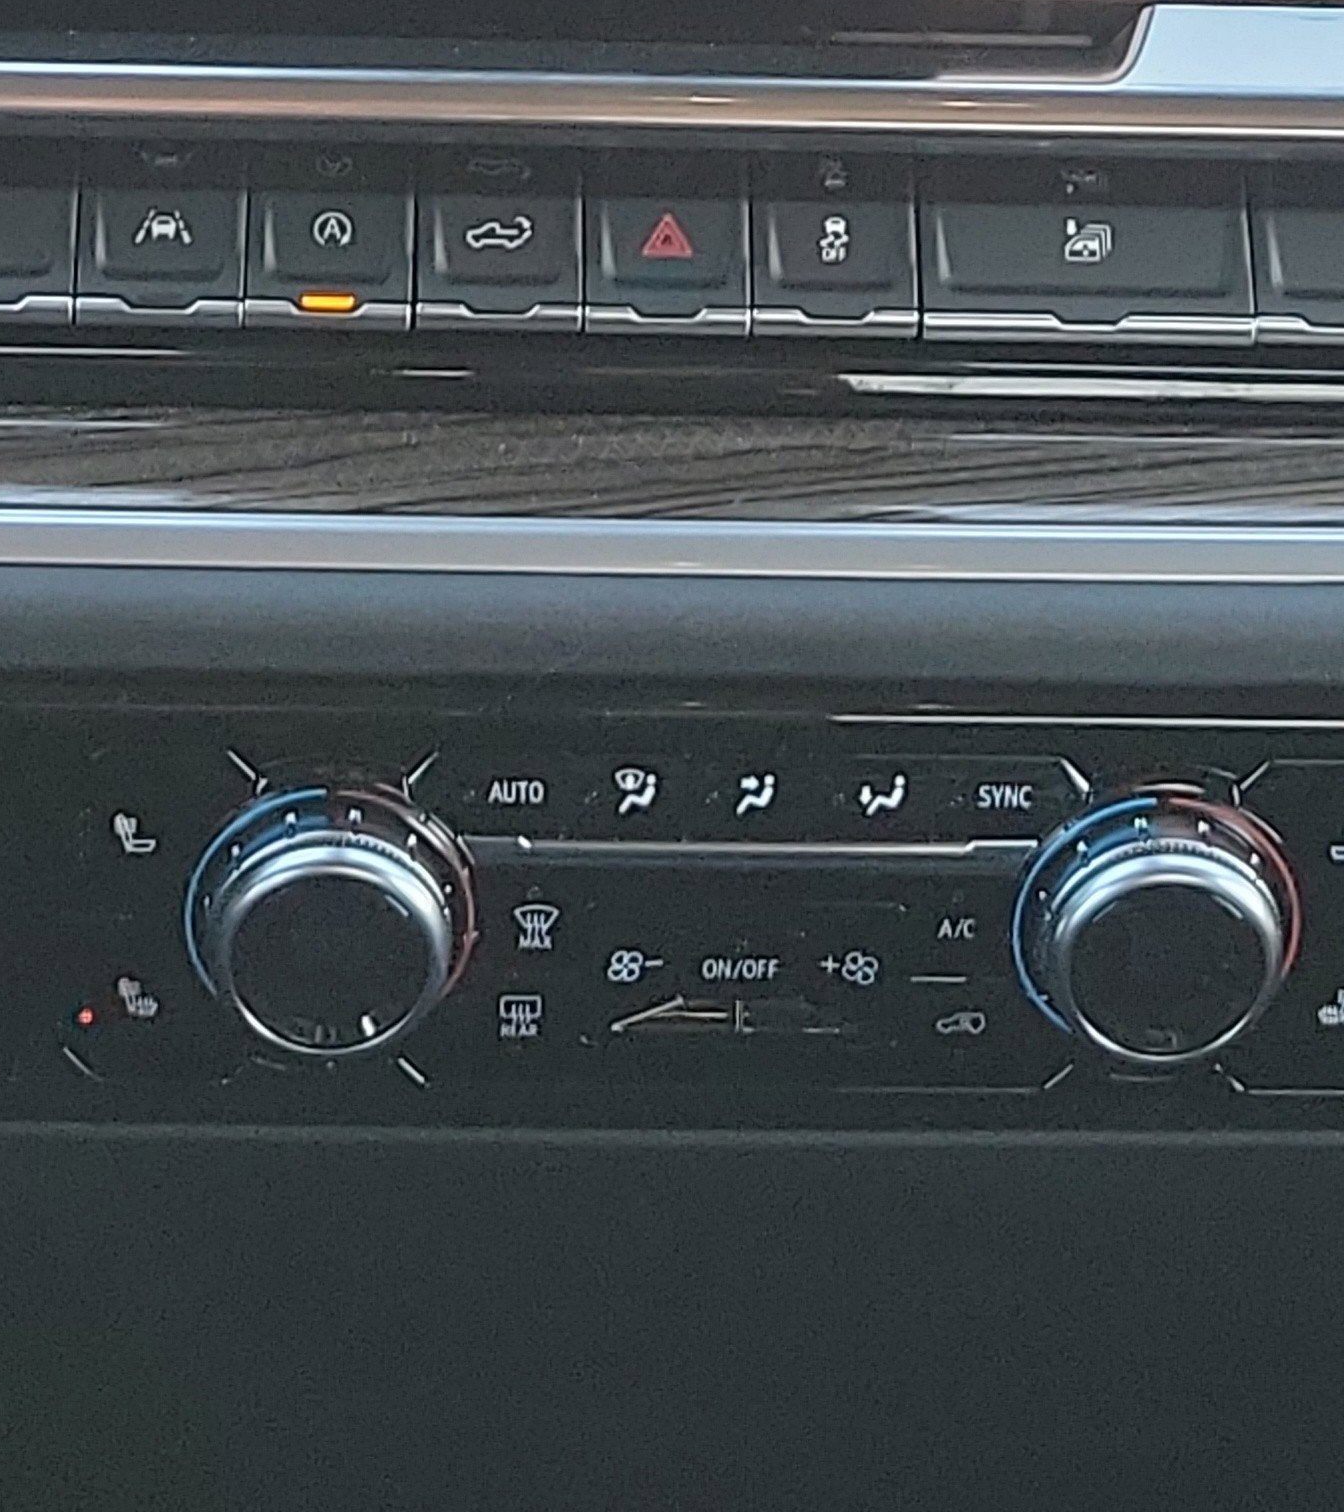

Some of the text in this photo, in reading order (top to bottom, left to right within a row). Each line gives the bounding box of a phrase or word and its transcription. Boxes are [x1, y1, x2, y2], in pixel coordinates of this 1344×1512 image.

[487, 780, 545, 804] AUTO
[976, 784, 1034, 809] SYNC
[937, 918, 976, 938] A/C
[518, 934, 553, 949] MAX
[702, 958, 780, 980] ON/OFF
